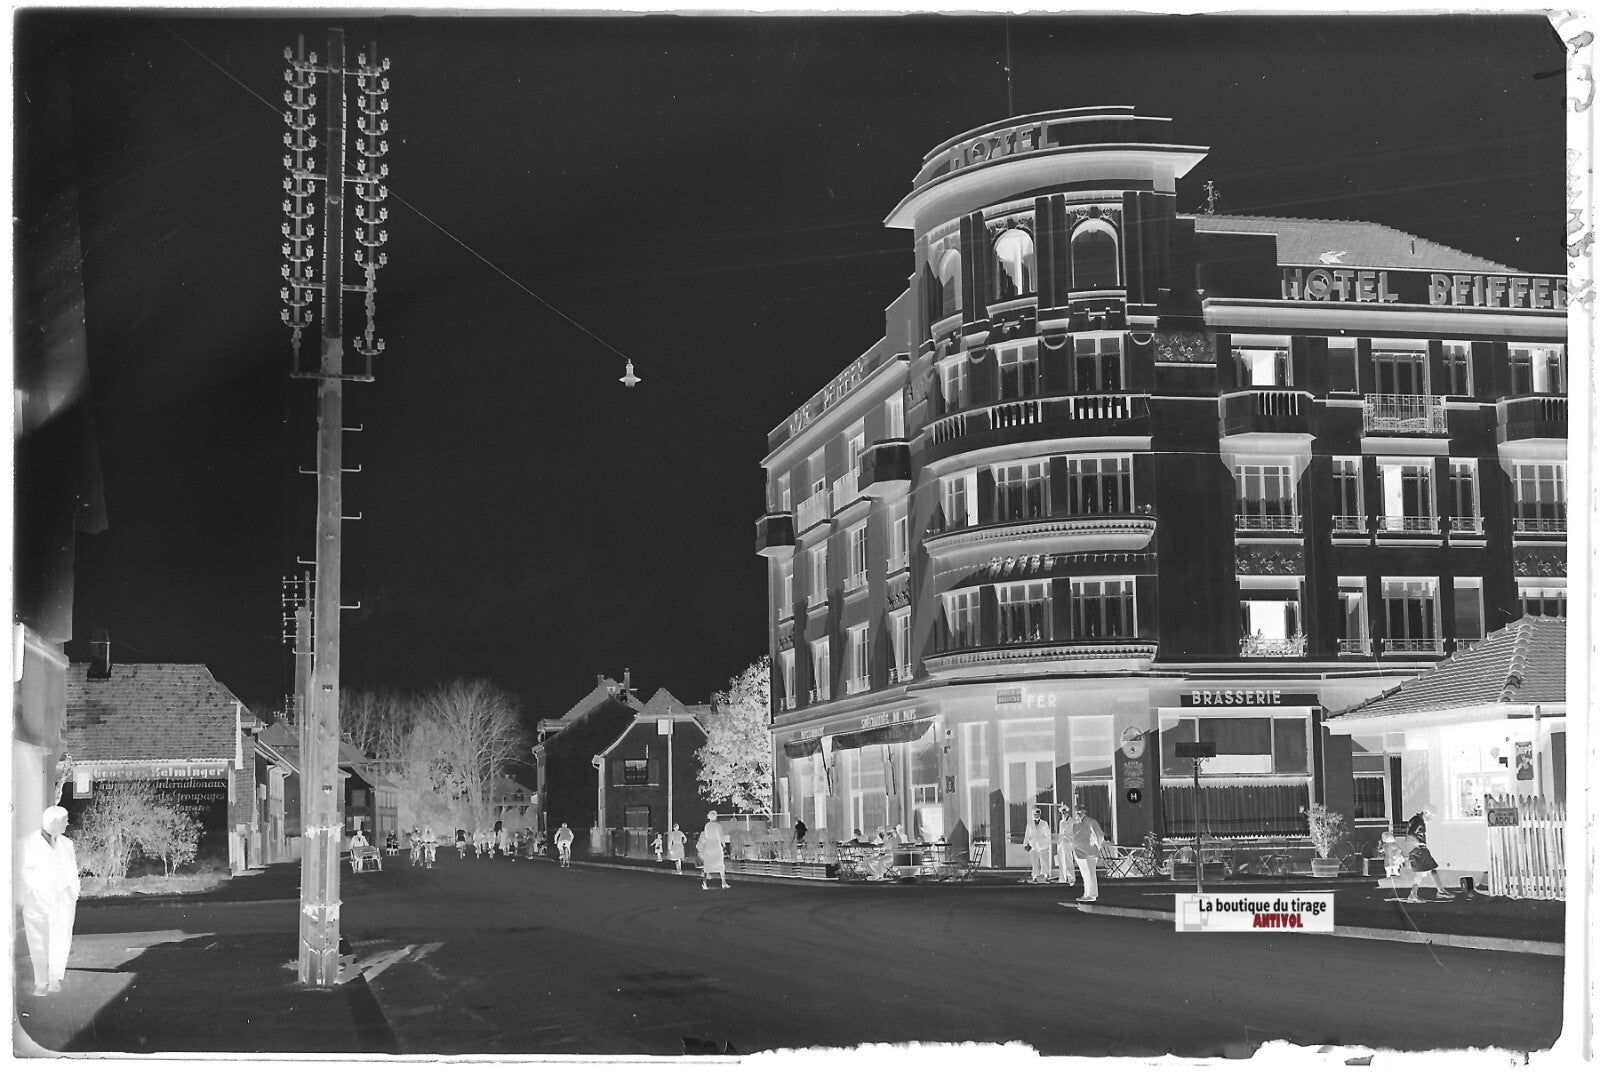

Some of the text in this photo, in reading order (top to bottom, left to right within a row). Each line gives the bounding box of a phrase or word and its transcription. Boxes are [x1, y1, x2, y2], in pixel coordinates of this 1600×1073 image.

[949, 121, 1060, 171] HOTEL
[1281, 267, 1399, 303] HOTEL
[1192, 690, 1281, 705] BRASSERIE
